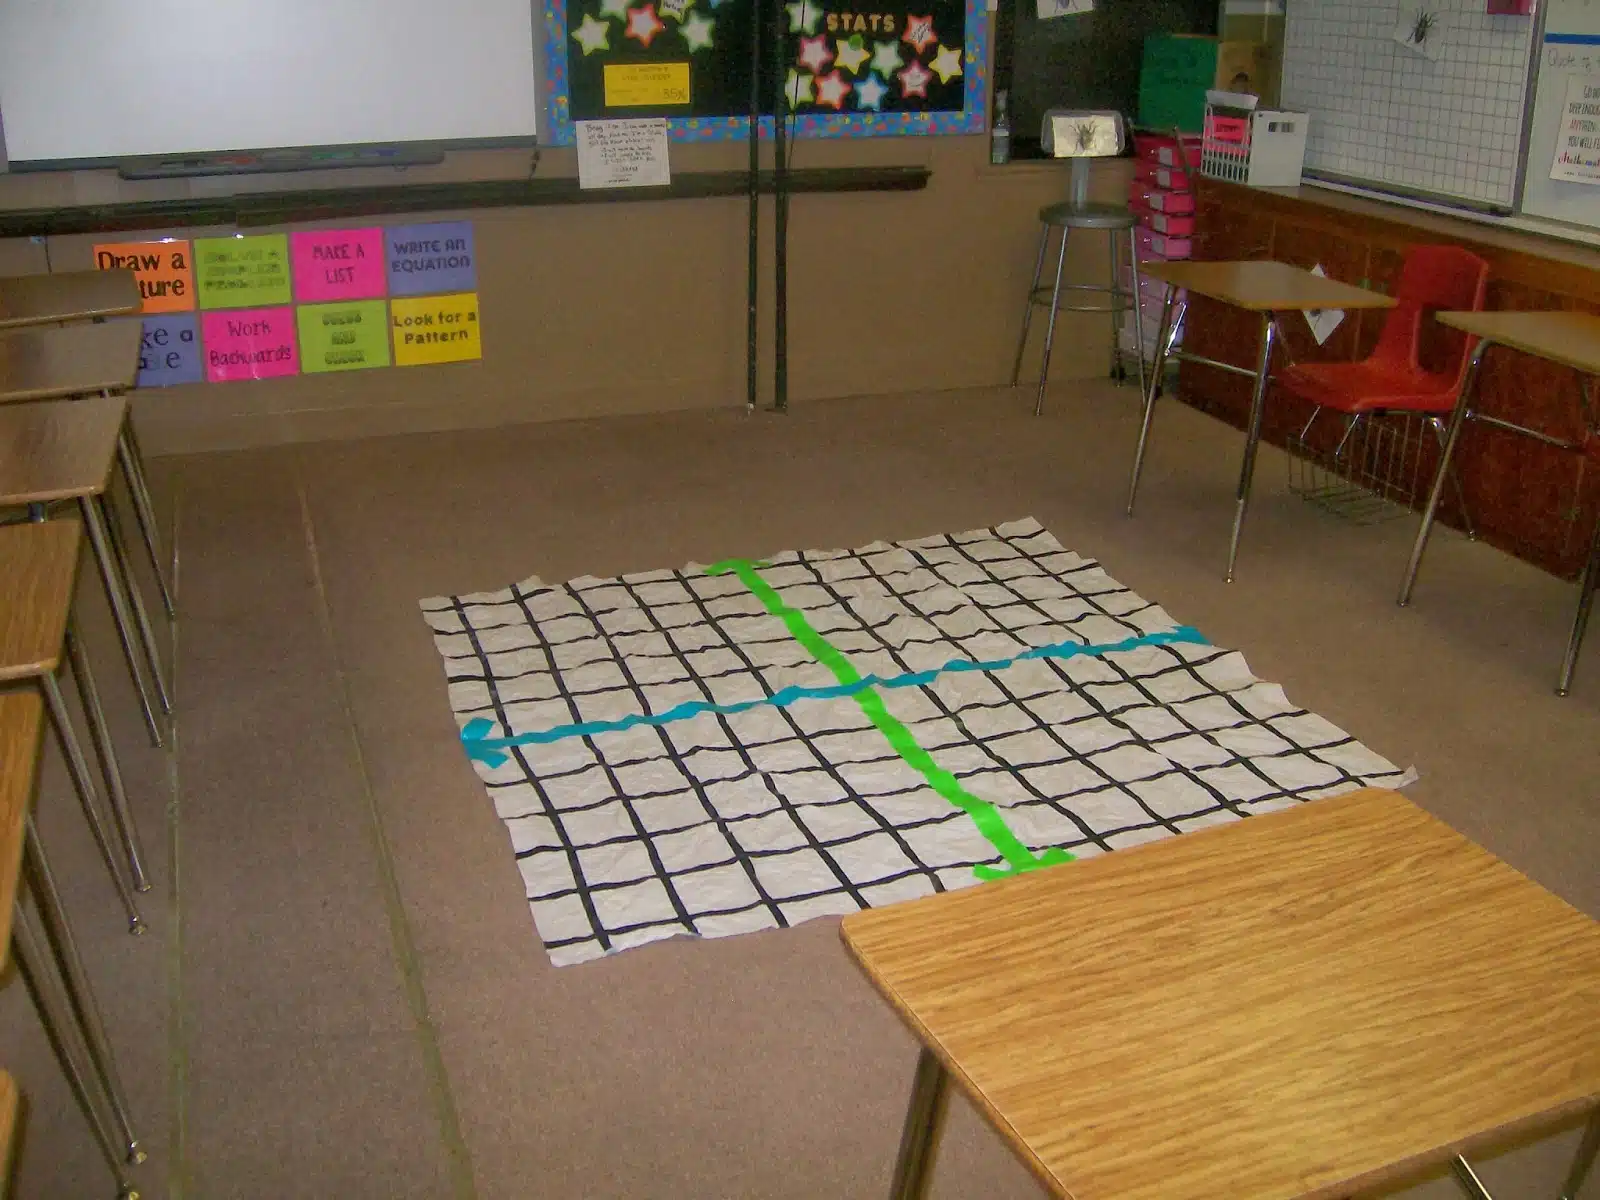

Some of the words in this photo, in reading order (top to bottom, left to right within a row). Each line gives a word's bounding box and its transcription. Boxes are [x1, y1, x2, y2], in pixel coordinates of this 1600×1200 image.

[826, 11, 895, 33] STATS
[312, 243, 352, 260] MAKE
[356, 243, 365, 259] A
[394, 240, 441, 255] WRITE
[445, 238, 466, 251] AN
[98, 251, 160, 272] Draw
[171, 252, 186, 270] a
[391, 255, 471, 274] EQUATION
[325, 266, 355, 284] LIST
[139, 279, 185, 299] ture
[227, 319, 272, 337] Work
[393, 313, 433, 328] Look
[437, 311, 464, 325] for
[467, 311, 477, 322] a
[140, 327, 169, 350] ke
[179, 329, 193, 343] a
[404, 329, 469, 345] Pattern
[209, 344, 292, 368] Backwards
